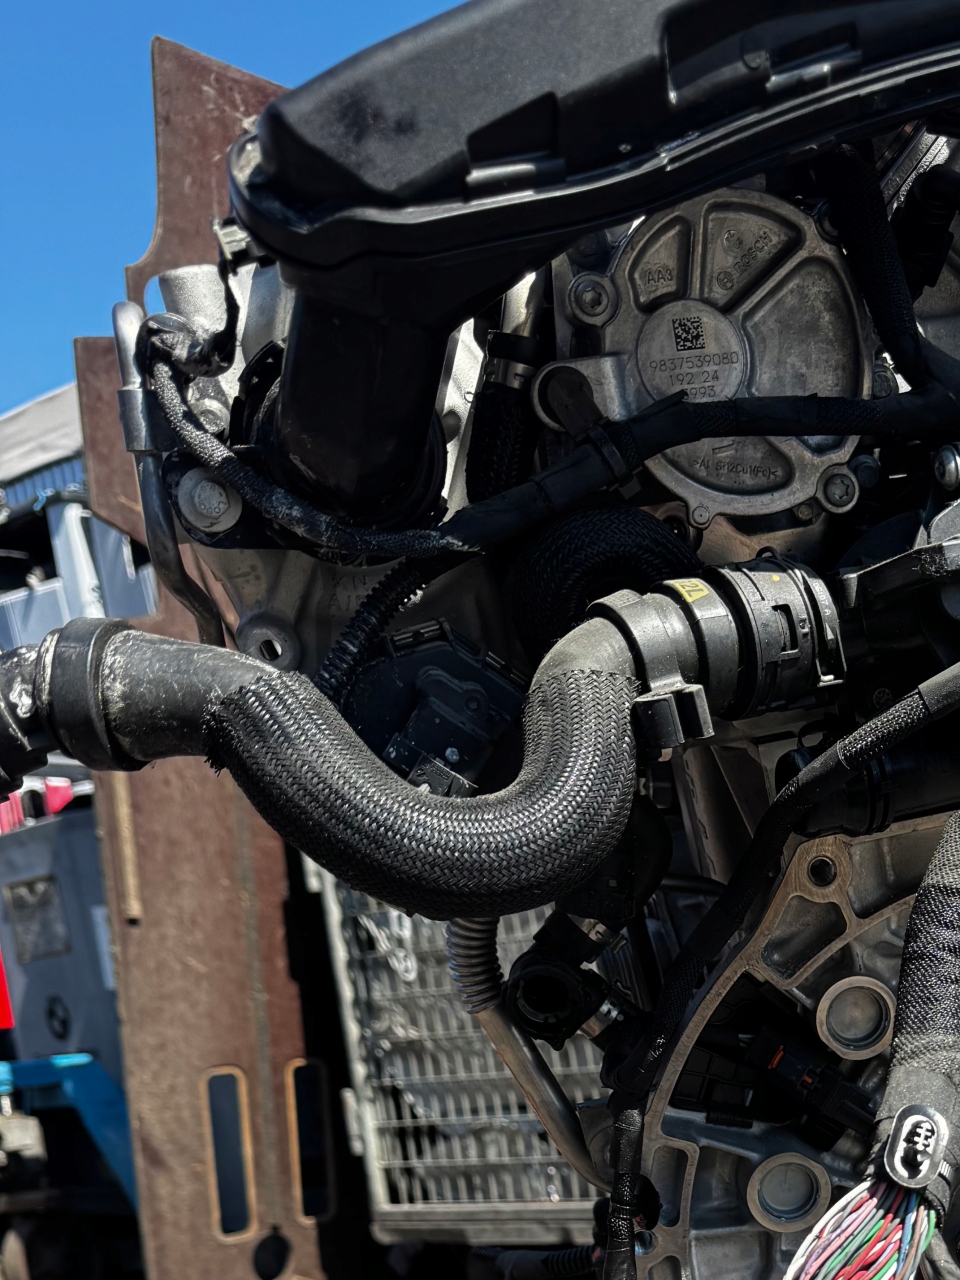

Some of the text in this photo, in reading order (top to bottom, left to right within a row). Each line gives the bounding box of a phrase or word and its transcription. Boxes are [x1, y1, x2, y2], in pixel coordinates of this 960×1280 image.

[733, 231, 774, 276] BOSCH
[646, 267, 674, 284] AA3
[649, 351, 739, 373] 9837539080
[669, 370, 719, 387] 192 24
